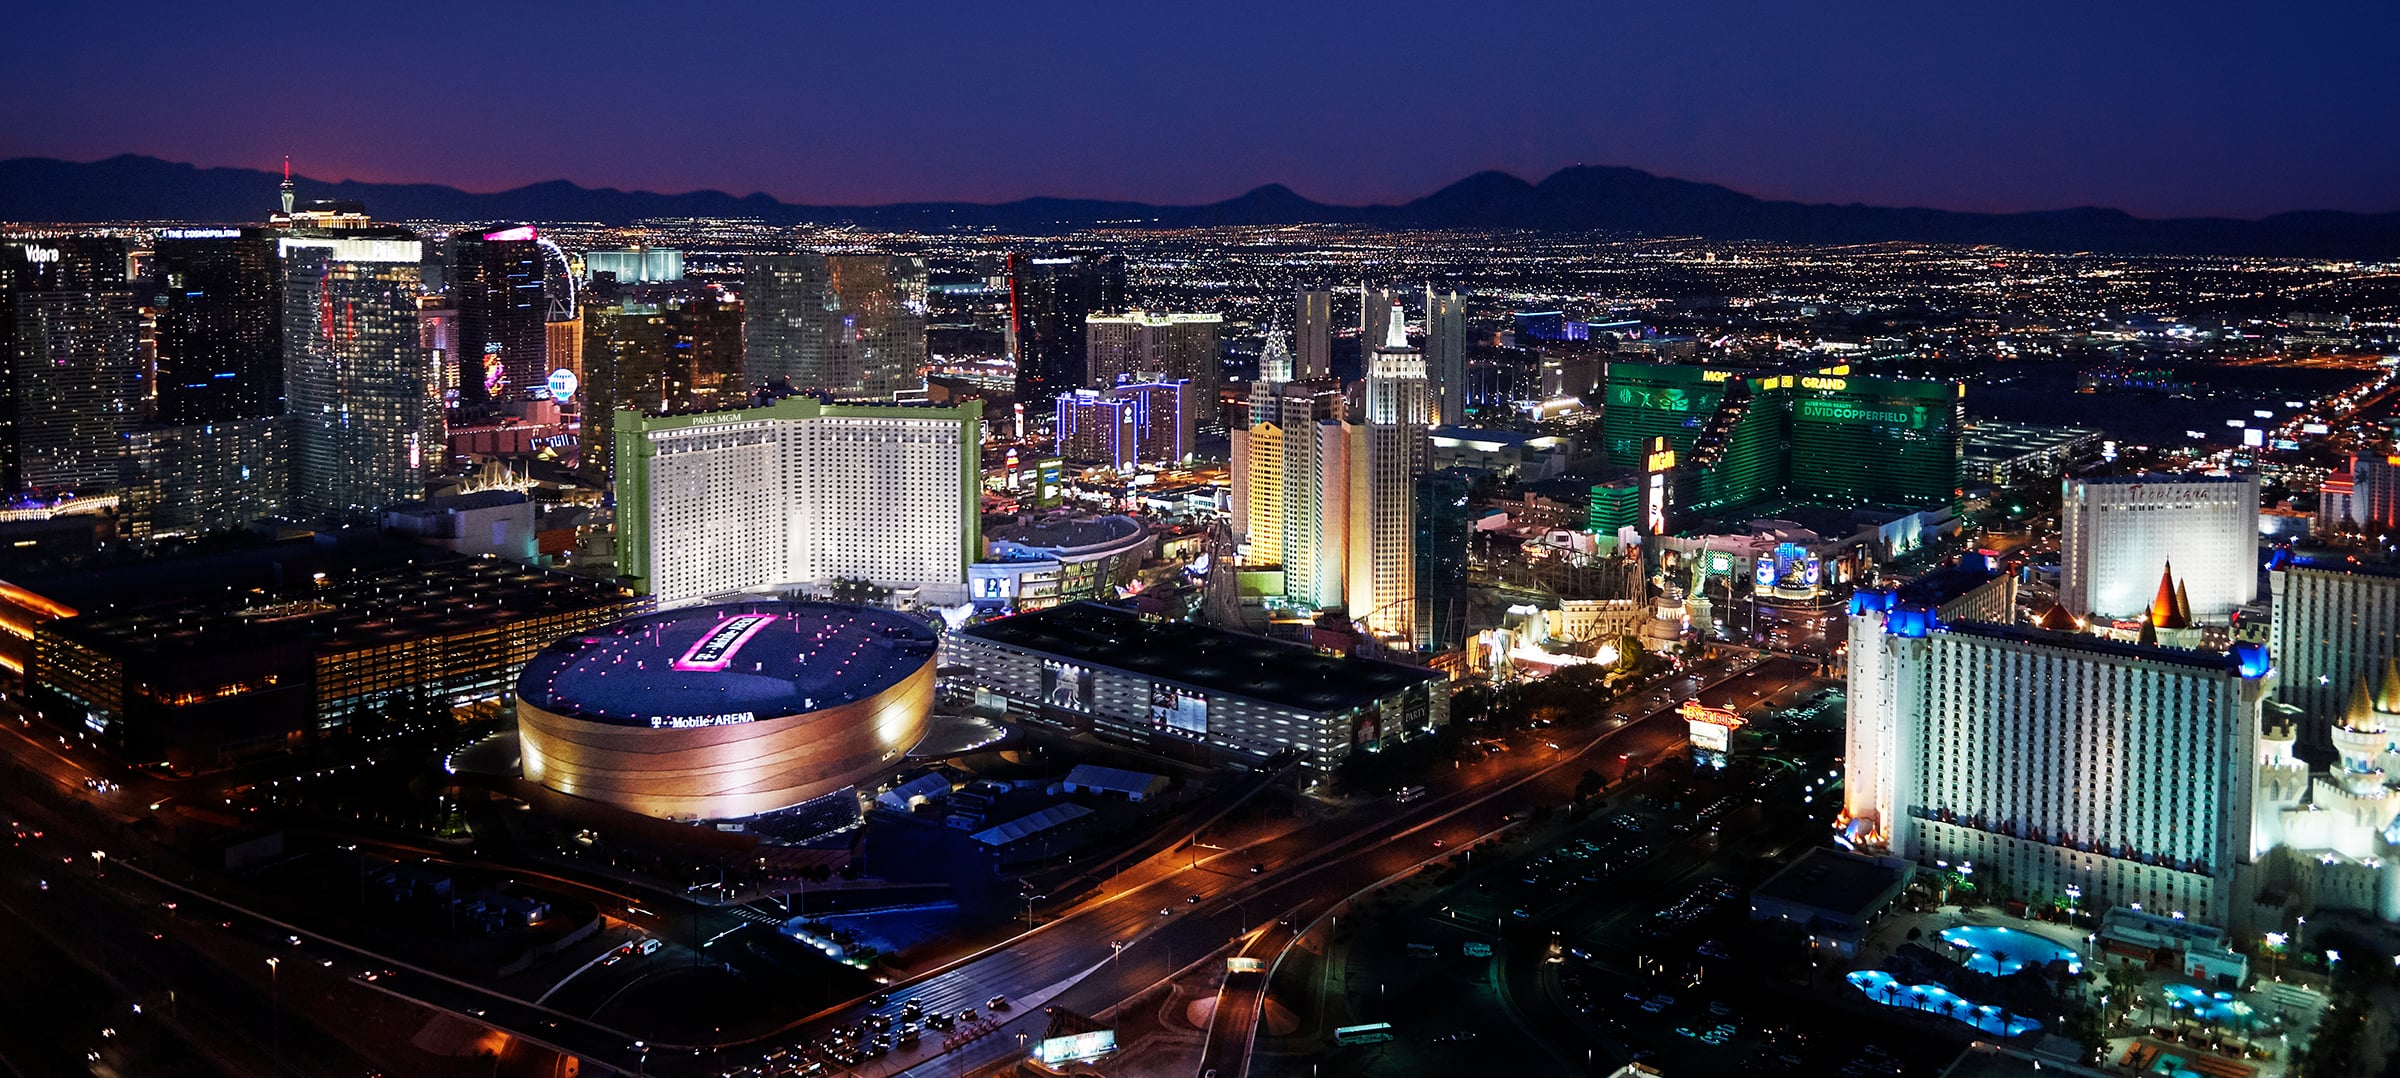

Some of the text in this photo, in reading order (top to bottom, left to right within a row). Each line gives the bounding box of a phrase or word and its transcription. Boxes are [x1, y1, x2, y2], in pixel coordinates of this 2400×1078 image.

[25, 244, 59, 263] Vdara
[1801, 377, 1846, 391] GRAND
[692, 413, 741, 425] PARK MGM
[1648, 450, 1675, 472] MGM
[715, 711, 755, 726] ARENA
[1405, 708, 1426, 723] PARTY
